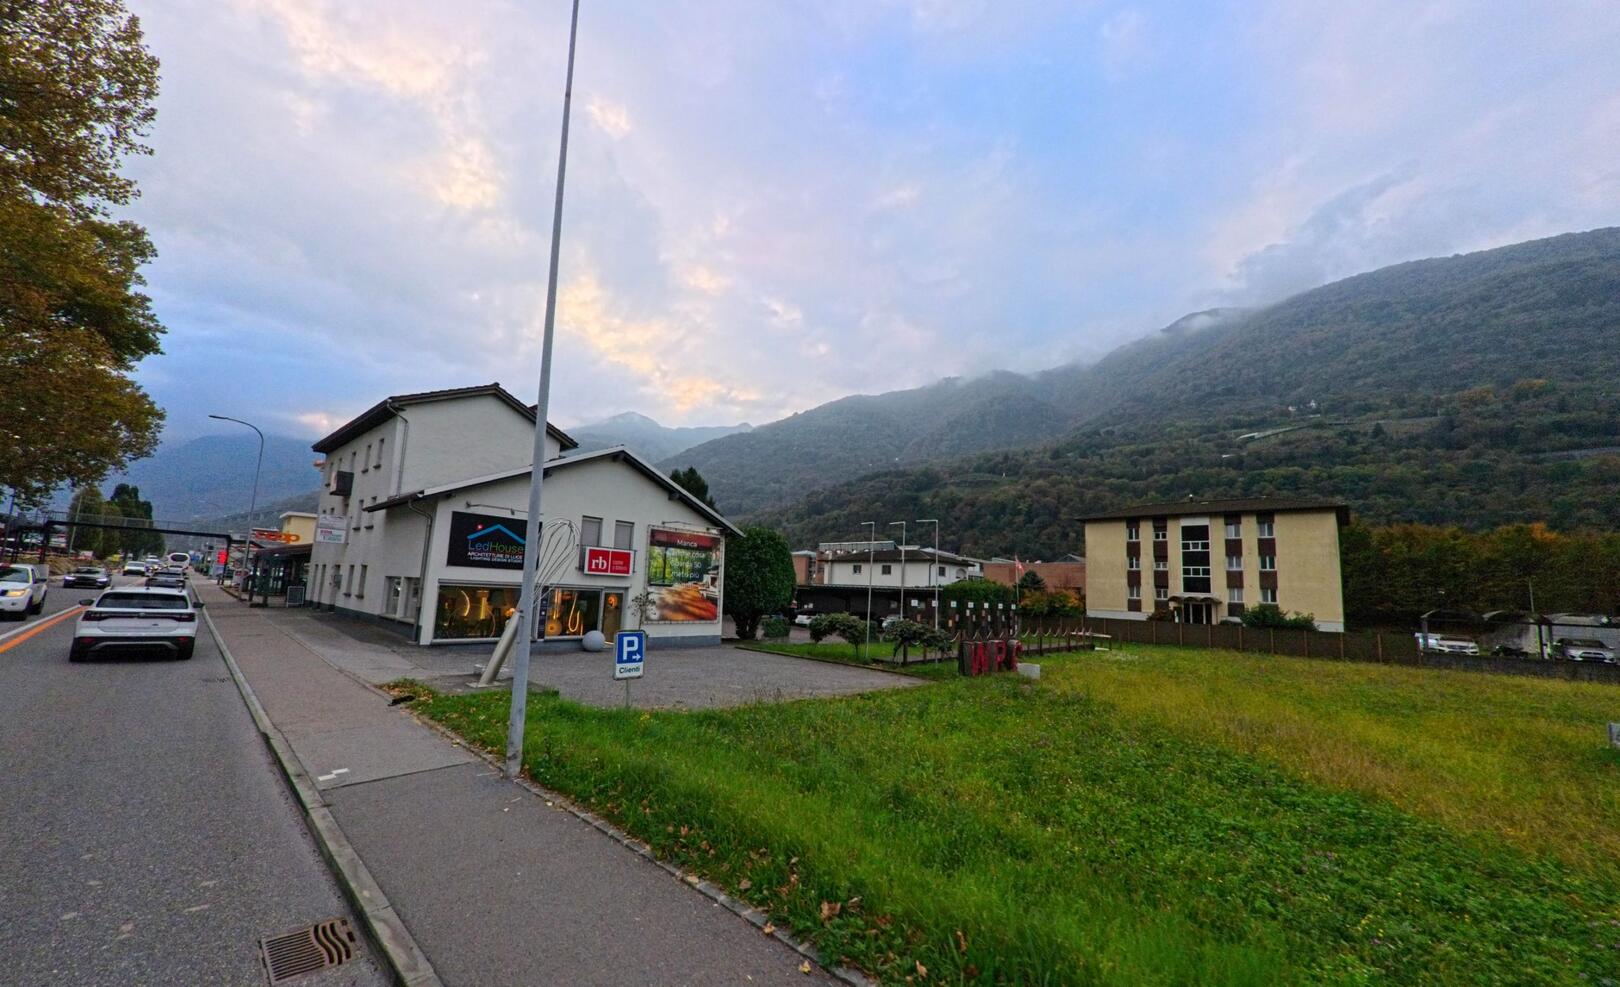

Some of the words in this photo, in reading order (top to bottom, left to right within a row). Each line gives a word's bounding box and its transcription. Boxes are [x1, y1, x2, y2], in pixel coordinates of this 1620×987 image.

[468, 540, 524, 554] LedHouse
[676, 539, 698, 548] Manca
[591, 556, 608, 570] rb
[623, 636, 639, 661] P
[619, 666, 641, 674] Clienti
